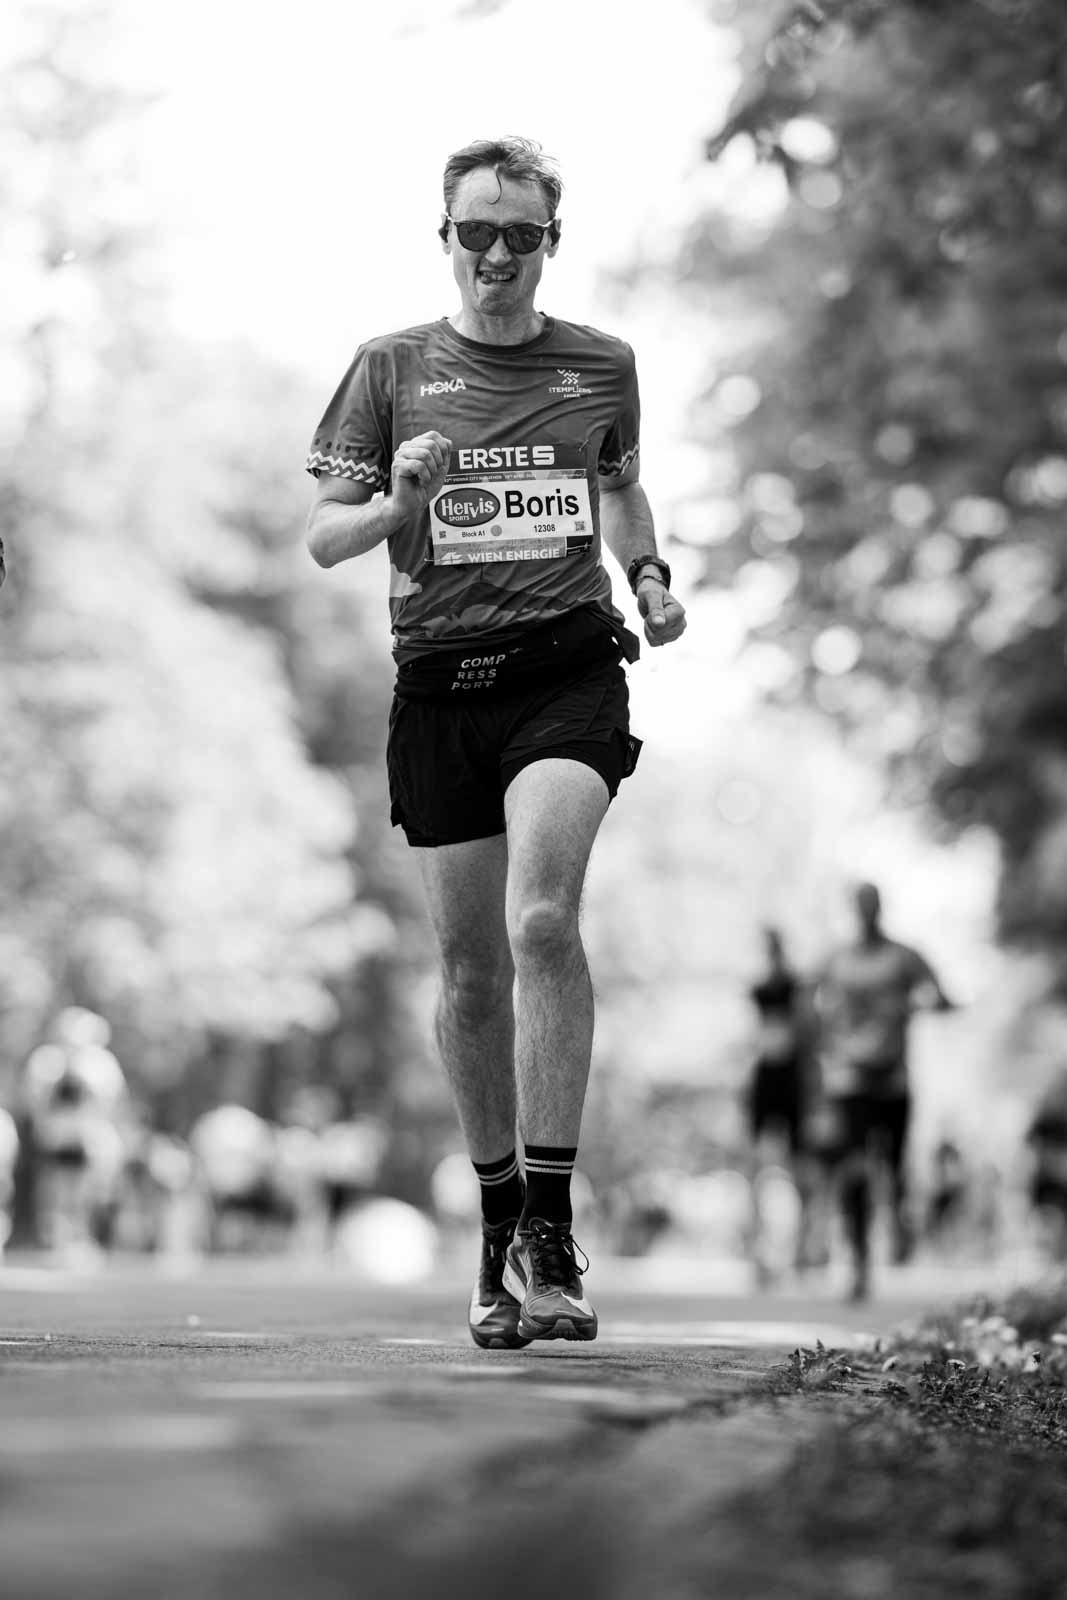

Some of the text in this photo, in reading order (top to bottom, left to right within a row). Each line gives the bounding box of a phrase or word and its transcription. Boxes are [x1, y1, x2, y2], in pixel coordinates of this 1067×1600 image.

[420, 378, 466, 397] HOKA
[457, 446, 530, 470] ERSTE
[441, 498, 495, 518] Hervis
[504, 488, 580, 518] Boris
[461, 530, 477, 538] Block
[534, 524, 556, 533] 12308
[468, 551, 502, 563] WIEN
[506, 548, 560, 561] ENERGIE
[460, 654, 506, 669] COMP
[457, 668, 497, 680] RESS
[450, 681, 494, 690] PORT
